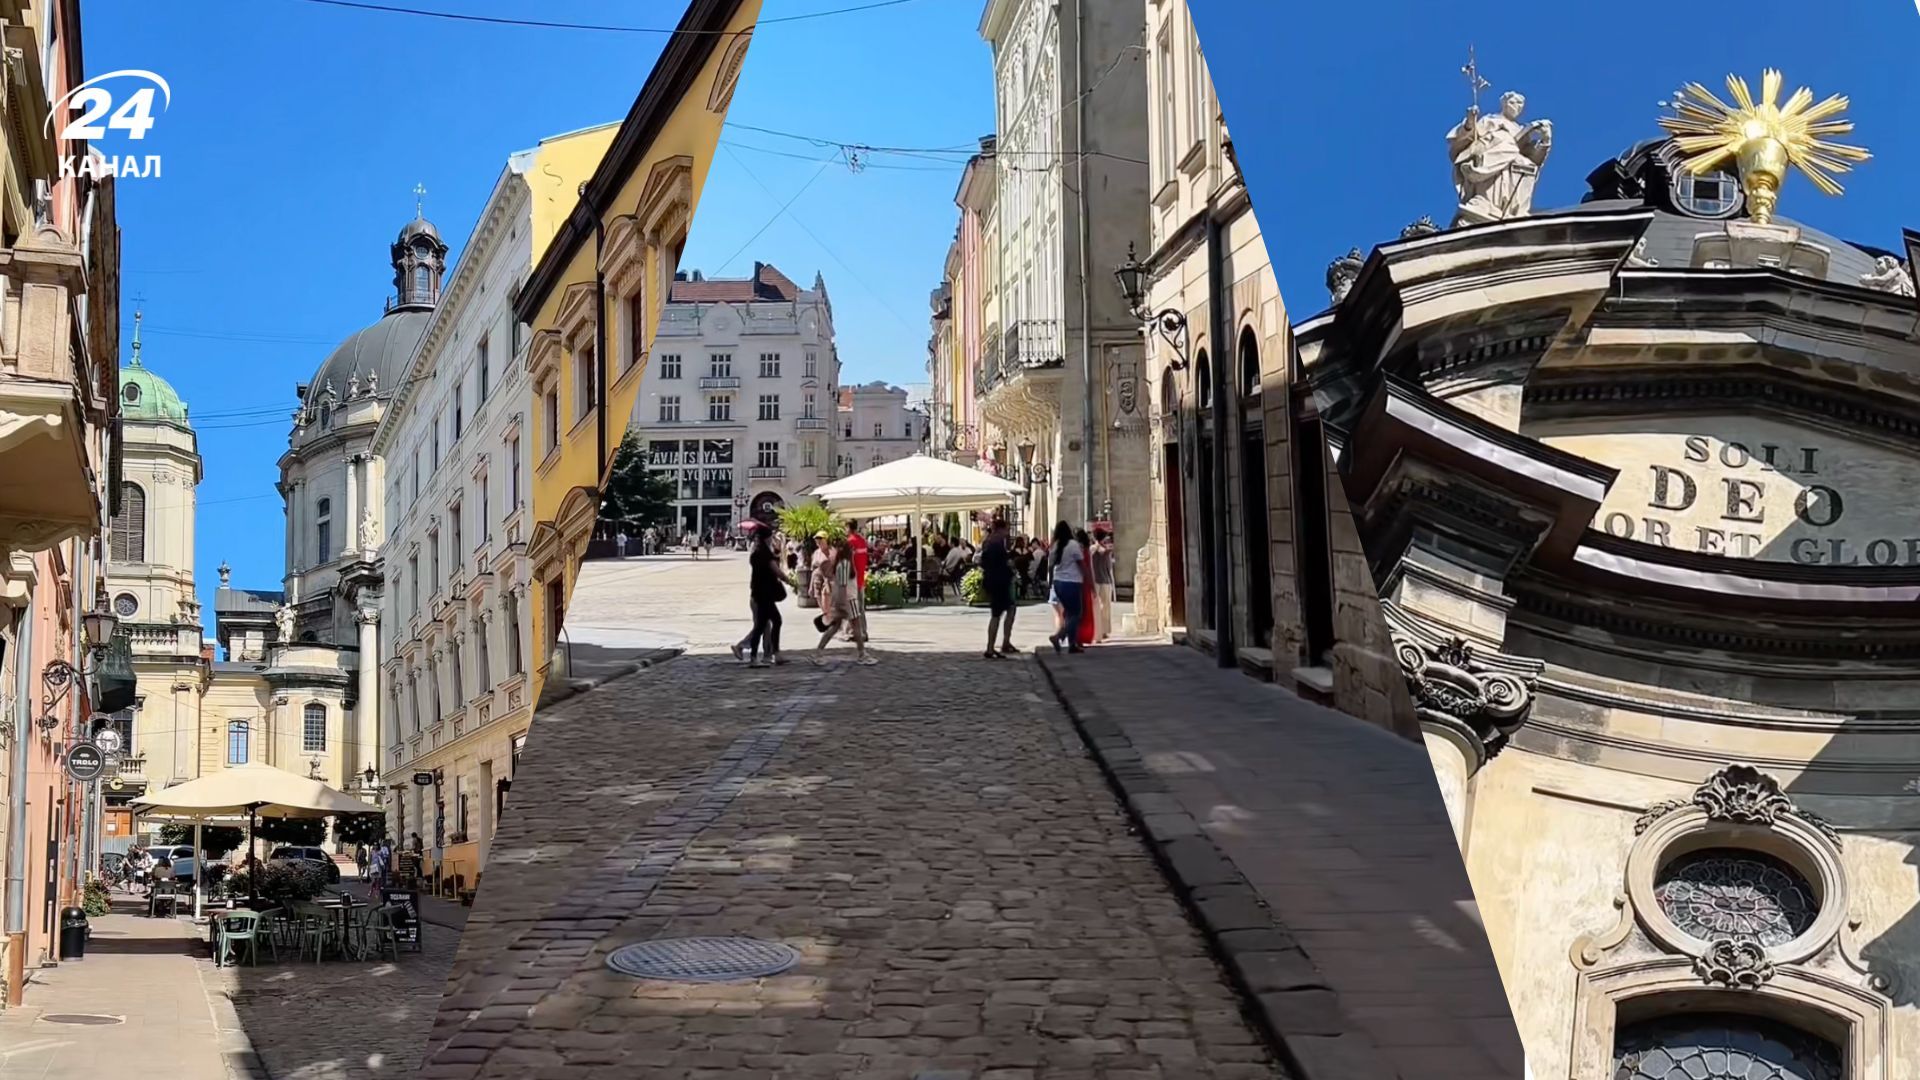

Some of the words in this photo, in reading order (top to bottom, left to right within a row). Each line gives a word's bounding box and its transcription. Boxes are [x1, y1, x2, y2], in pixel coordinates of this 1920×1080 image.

[1683, 436, 1818, 474] SOLI
[1648, 464, 1843, 527] DEO
[1694, 525, 1762, 557] ET
